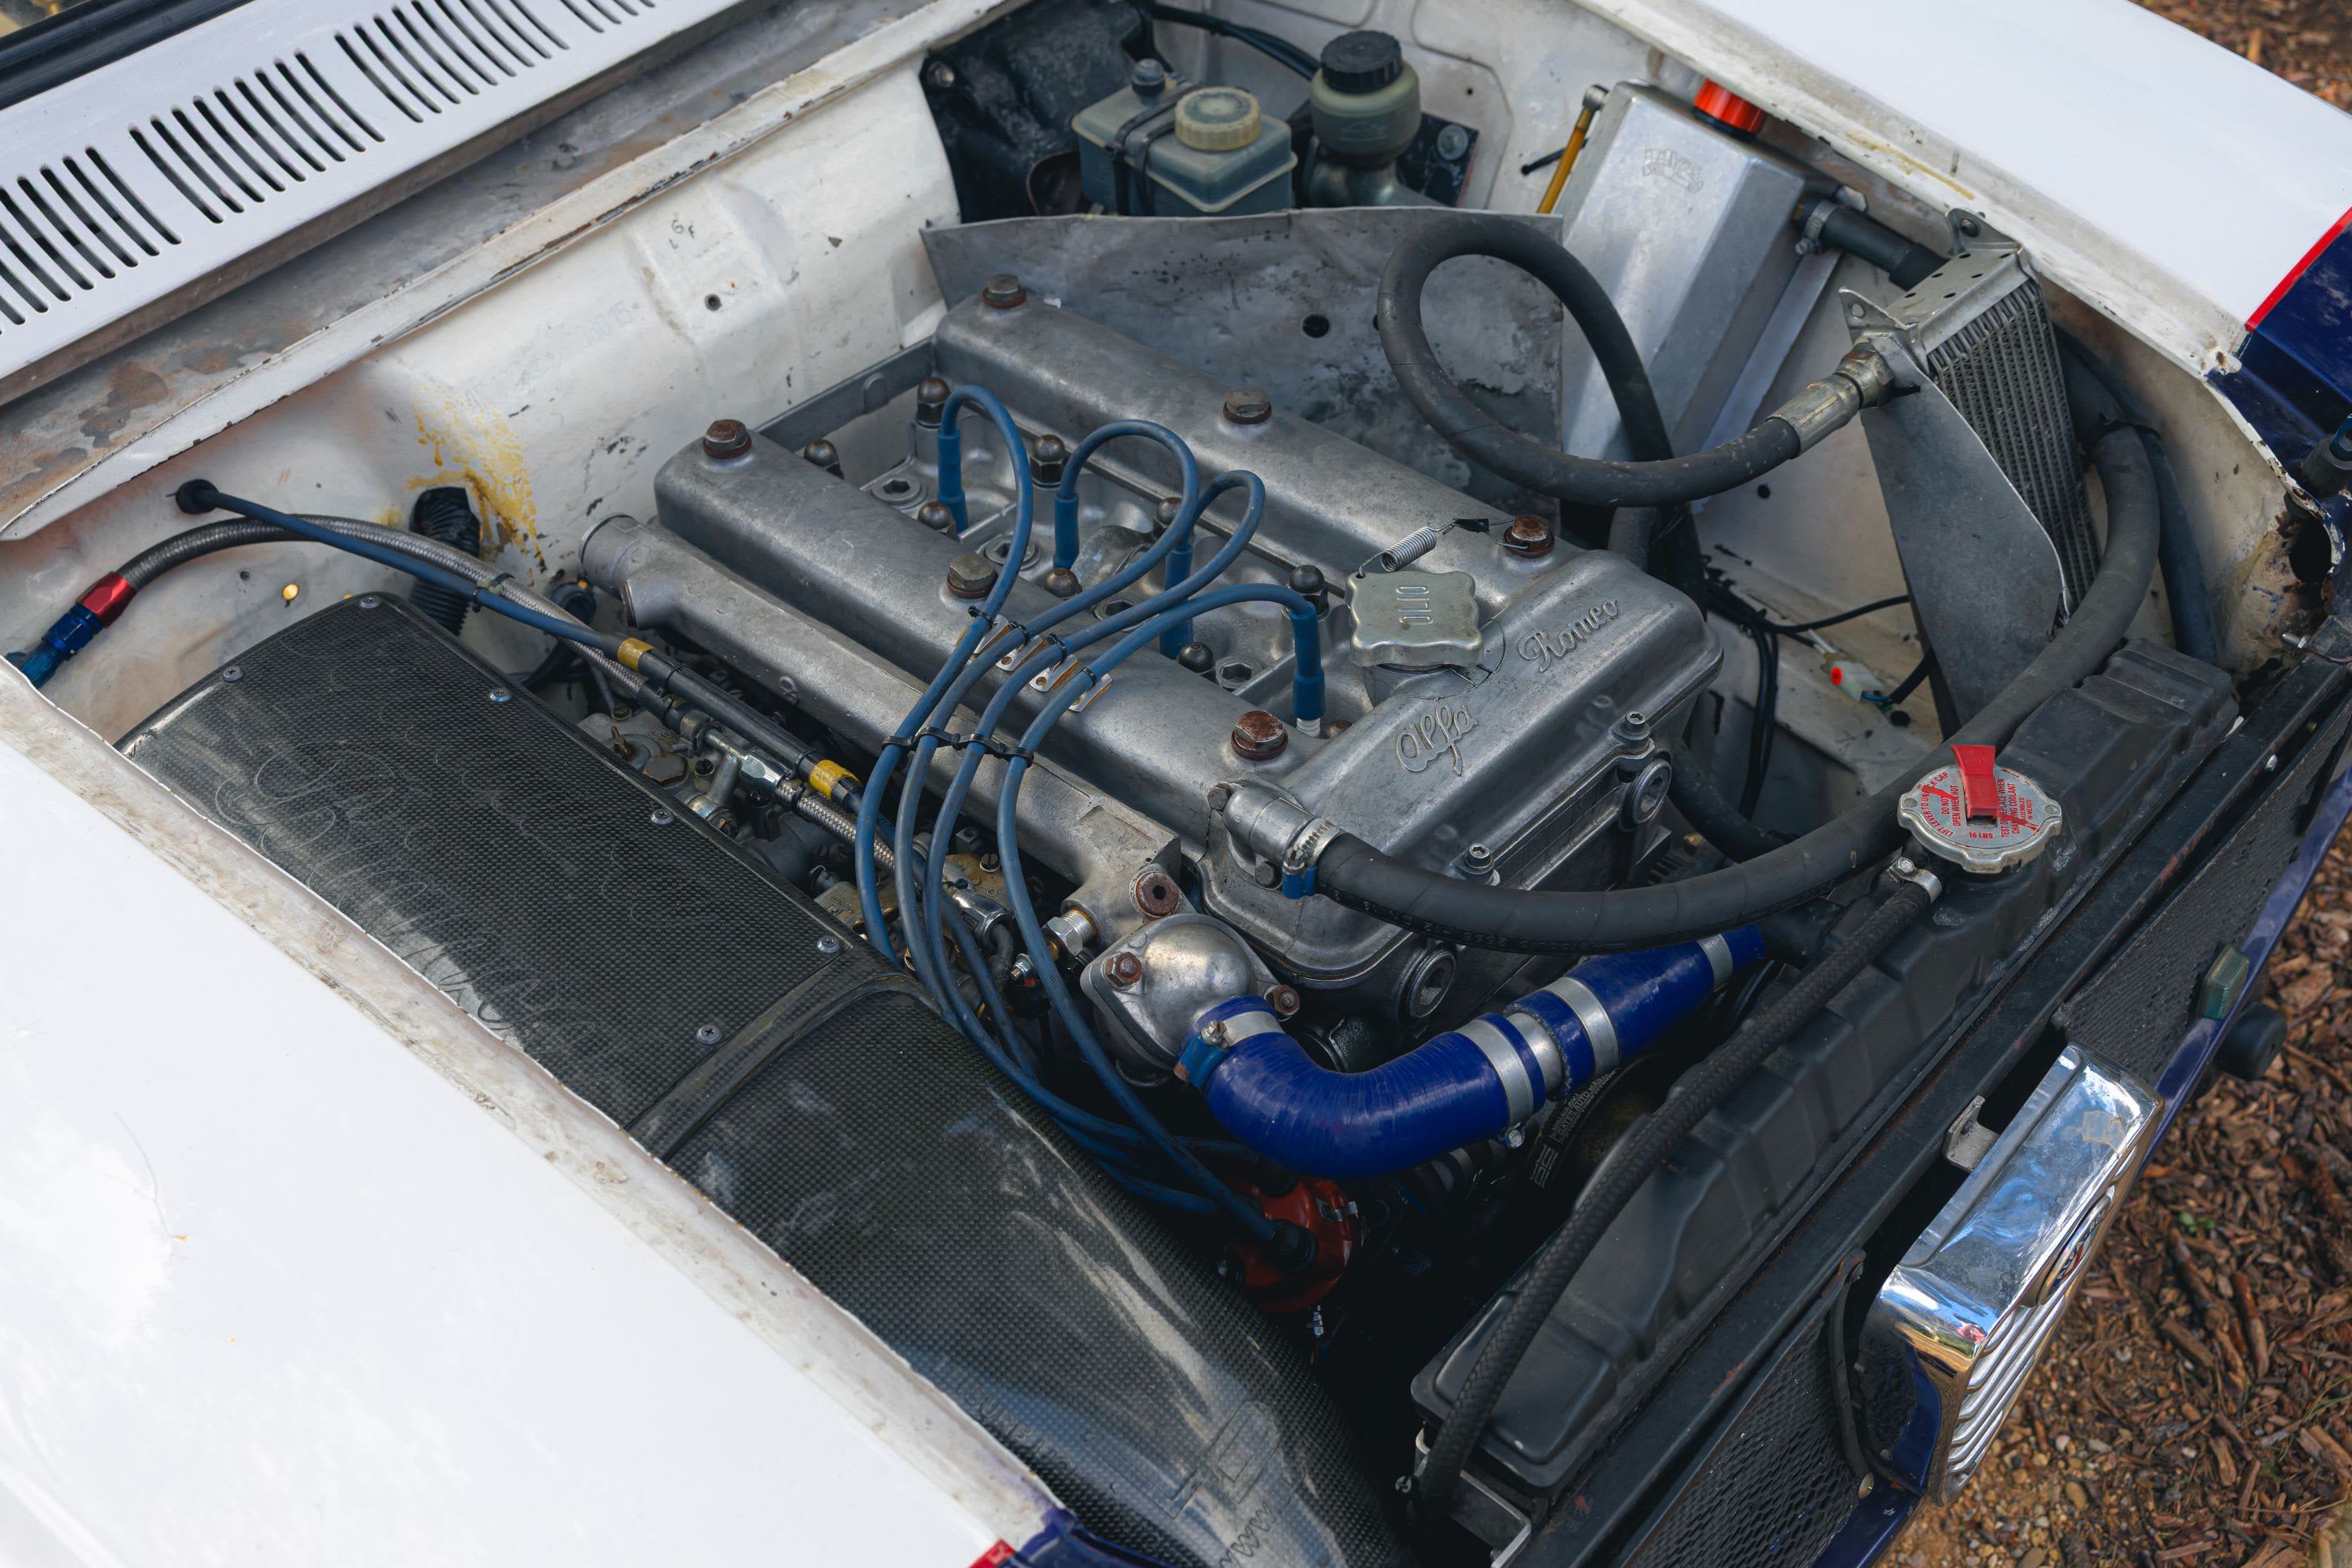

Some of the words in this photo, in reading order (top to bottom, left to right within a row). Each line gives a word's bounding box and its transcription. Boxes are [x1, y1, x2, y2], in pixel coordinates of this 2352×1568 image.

[1395, 585, 1433, 626] OLIO
[1395, 702, 1479, 776] Alfa
[1517, 598, 1621, 673] Romeo
[1934, 771, 1948, 782] CAP
[2007, 782, 2017, 807] COOLANT
[1998, 795, 2007, 814] EPLACE
[1923, 811, 1940, 828] LEVER
[1952, 813, 1961, 826] OPEN
[1937, 826, 1954, 837] LIFT
[2001, 826, 2010, 838] TEST
[1558, 1110, 1576, 1135] GATES
[1573, 1091, 1590, 1110] AUTO
